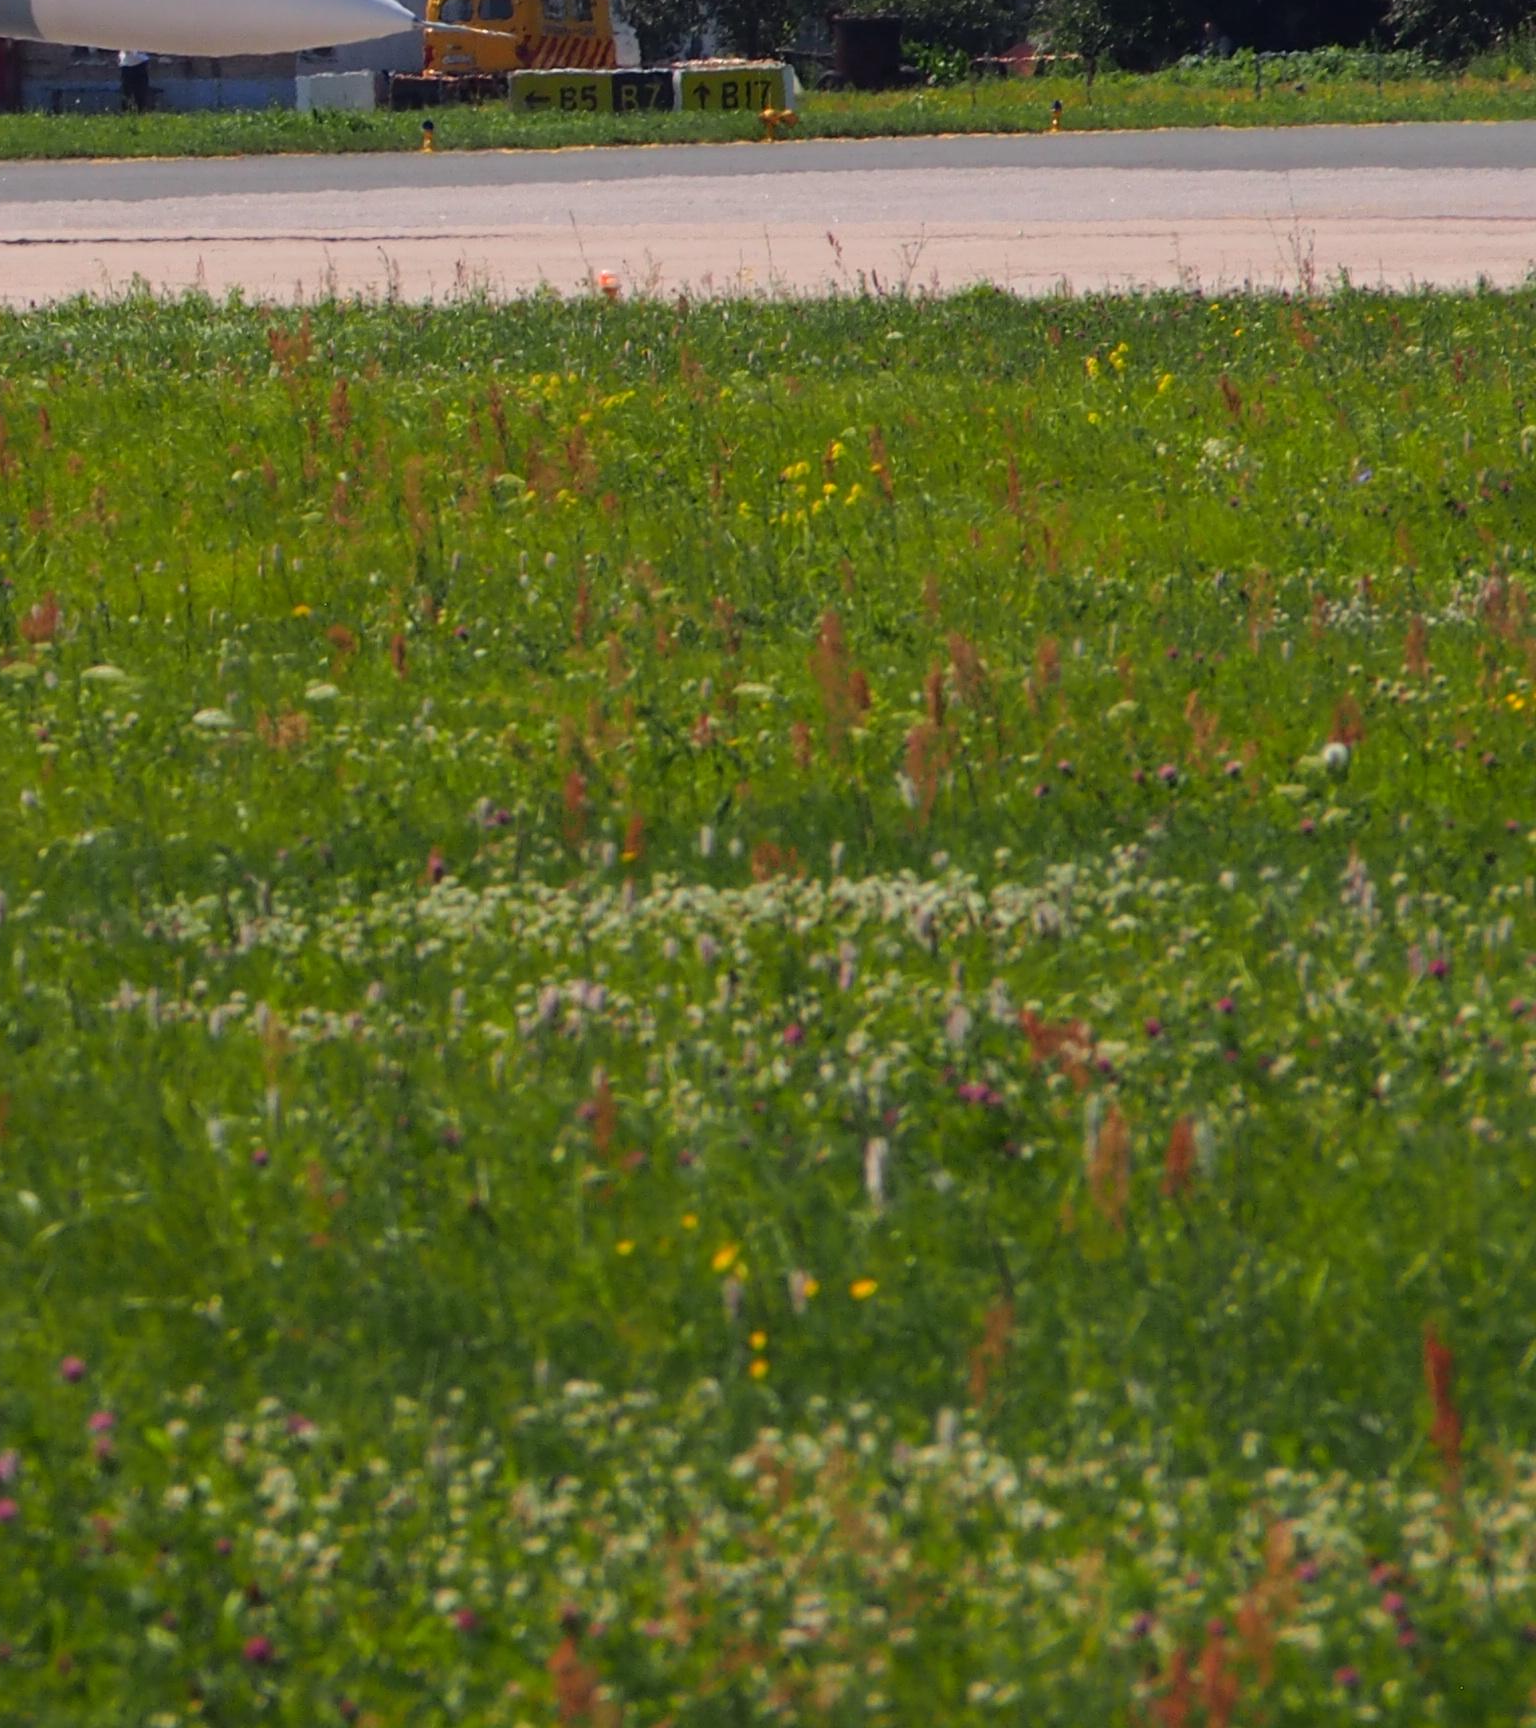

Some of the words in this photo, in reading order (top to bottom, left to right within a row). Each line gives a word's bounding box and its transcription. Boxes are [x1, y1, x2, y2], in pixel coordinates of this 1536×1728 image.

[559, 85, 598, 112] B5
[621, 83, 662, 111] B7
[721, 80, 772, 110] B17
